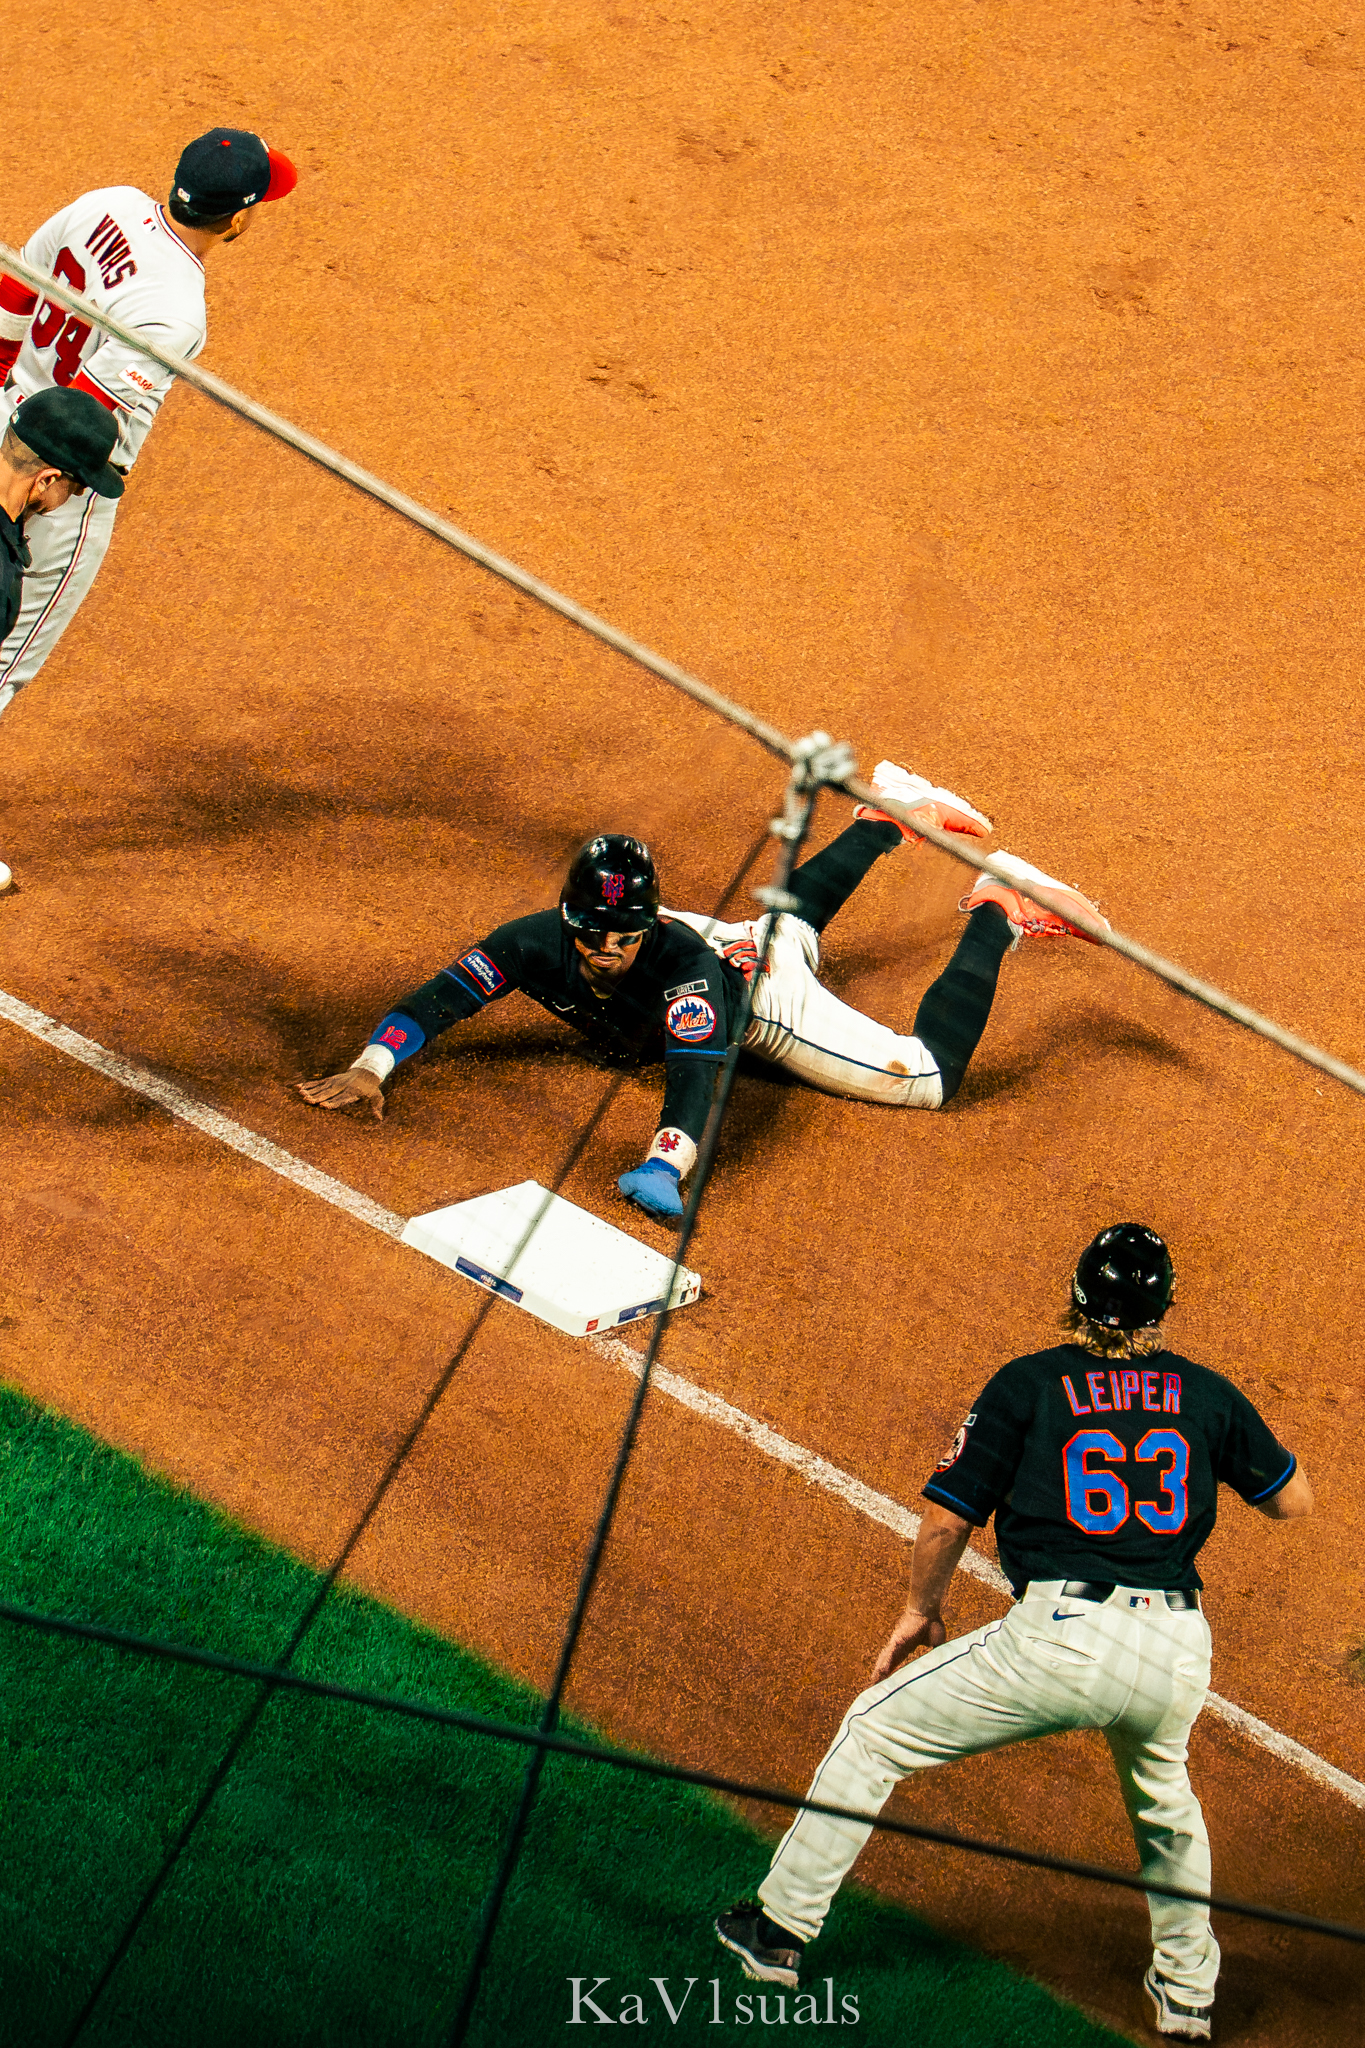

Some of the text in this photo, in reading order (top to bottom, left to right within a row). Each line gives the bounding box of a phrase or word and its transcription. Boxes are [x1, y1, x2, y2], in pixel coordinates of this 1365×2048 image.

[85, 213, 137, 289] VIVAS
[125, 369, 155, 391] AARP
[378, 1026, 407, 1050] 12
[675, 1011, 708, 1031] Mets
[1062, 1370, 1182, 1416] LEIPER
[1062, 1428, 1191, 1535] 63
